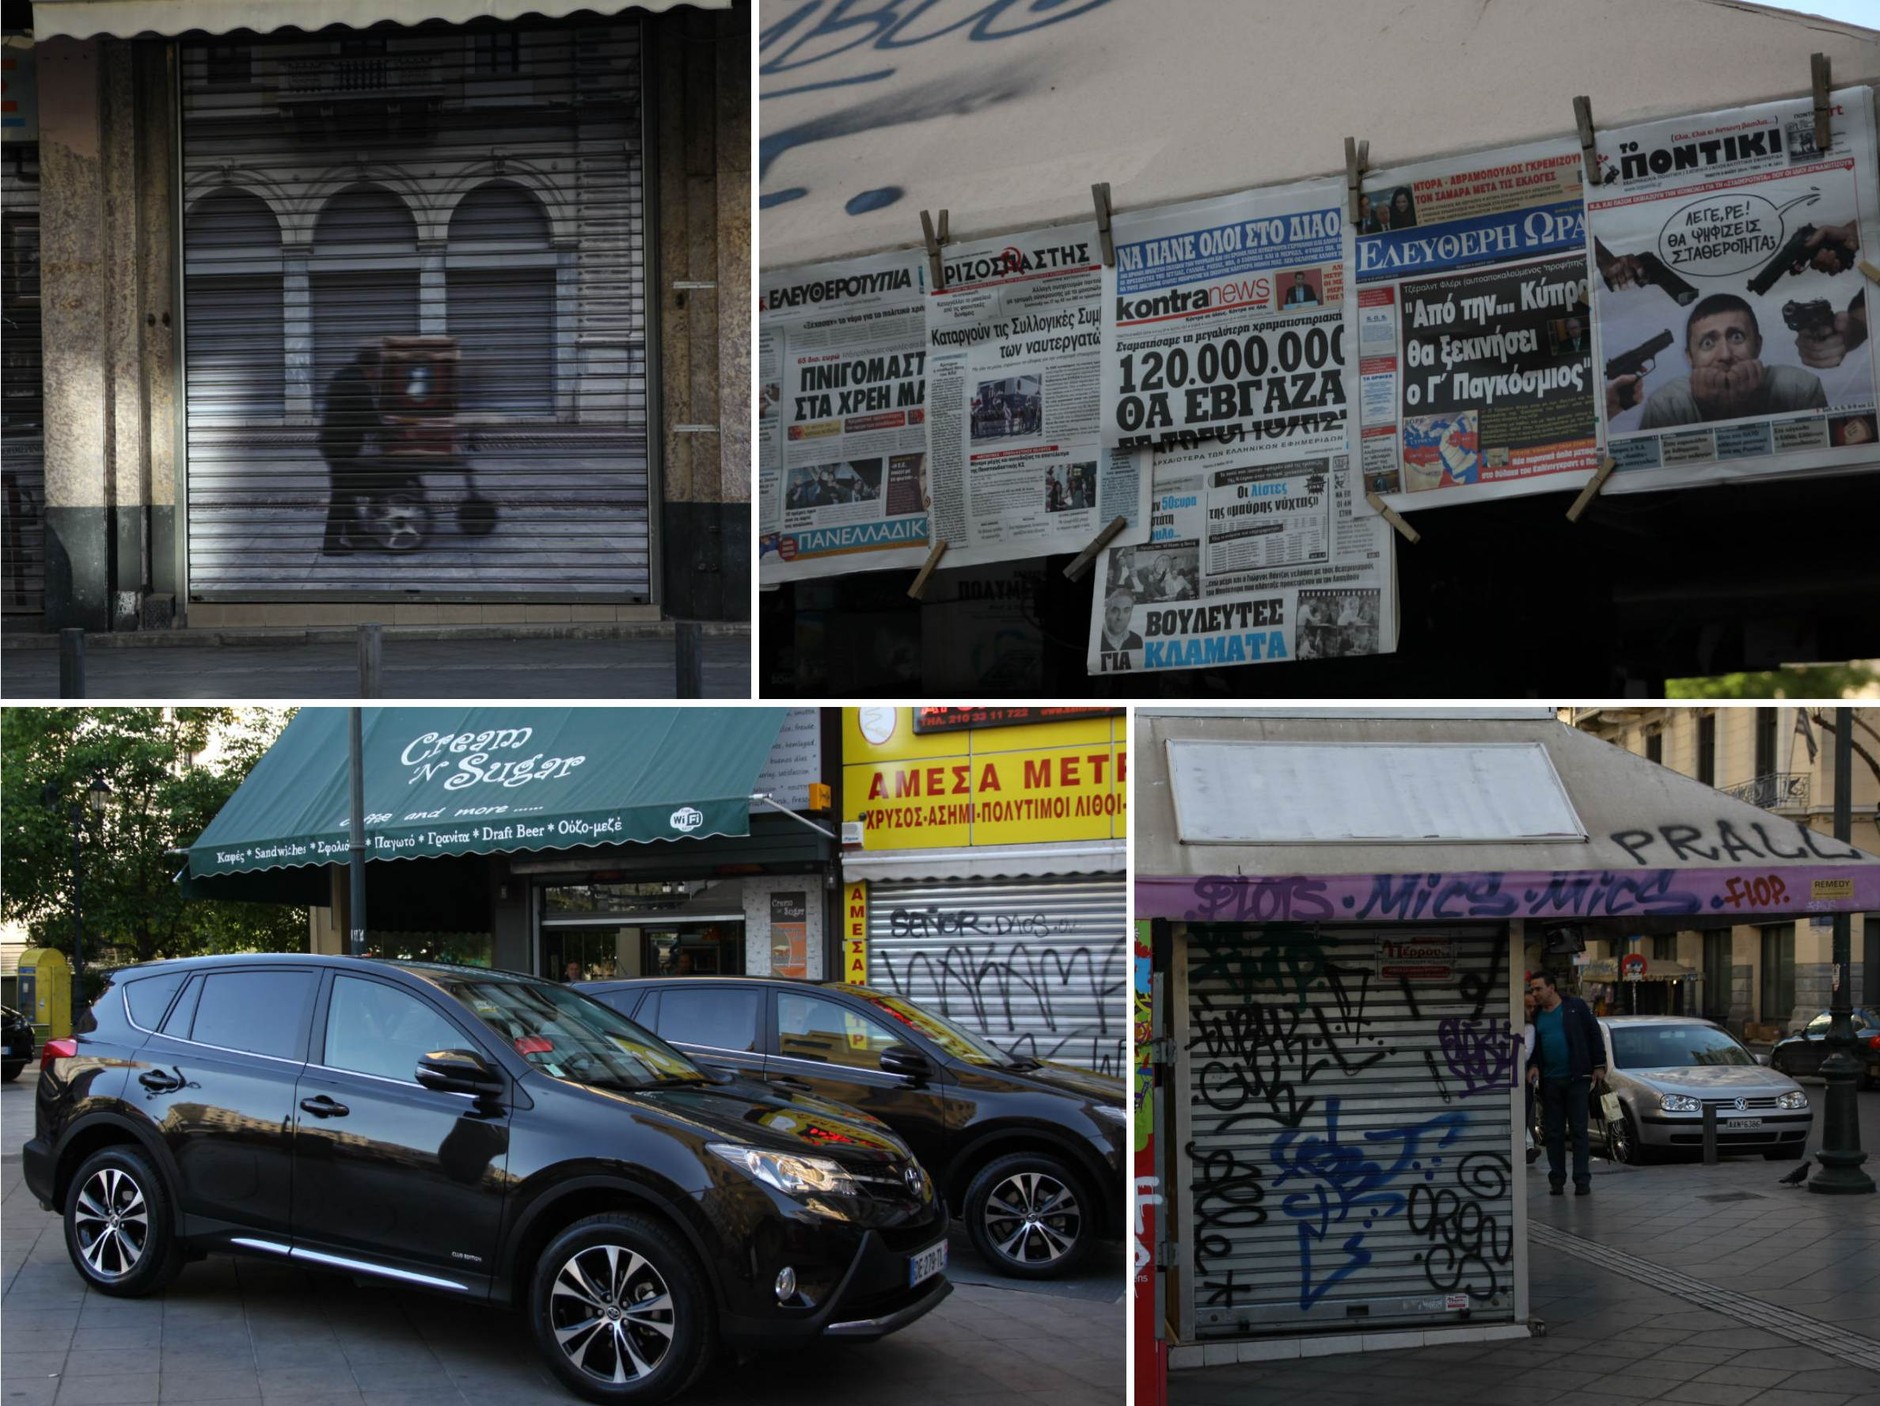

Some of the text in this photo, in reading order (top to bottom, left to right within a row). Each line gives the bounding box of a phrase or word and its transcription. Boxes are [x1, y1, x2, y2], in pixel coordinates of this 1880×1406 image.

[1619, 141, 1639, 153] ΤΟ
[1620, 128, 1783, 179] ΠΟΝΤΙΚΙ
[1414, 178, 1443, 192] ΝΤΟΡΑ
[1450, 165, 1524, 185] ΑΒΡΑΜΟΠΟΥΛΟΣ
[1415, 172, 1557, 205] ΤΟΝ ΣΑΜΑΡΑ ΜΕΤΑ ΤΙΣ ΕΚΛΟΓΕΣ
[1724, 201, 1750, 221] ΡΕ!
[1119, 247, 1142, 271] ΝΑ
[1146, 235, 1195, 267] ΠΑΝΕ
[1200, 226, 1242, 256] ΟΛΟΙ
[1245, 219, 1284, 246] ΣΤΟ
[1289, 210, 1342, 241] ΔΙΑΟ
[1357, 223, 1518, 273] ΕΛΕΥΘΕΡΗ
[1523, 211, 1587, 247] ΩΡΑ
[1667, 233, 1686, 248] ΘΑ
[769, 268, 912, 310] ΕΛΕΥΘΕΡΟΤΥΠΙΑ
[1116, 278, 1270, 322] kontranews
[931, 306, 1101, 348] Καταργούν τις Συλλογικές Συμ
[1405, 293, 1456, 329] "Από
[1461, 293, 1516, 326] την...
[1000, 343, 1022, 359] των
[1026, 327, 1101, 355] ναυτεργατώ
[1116, 334, 1181, 353] Σταματήσαμε
[1183, 334, 1194, 343] τη
[1195, 324, 1251, 343] μεγαλύτερη
[1252, 312, 1343, 333] χρηματιστηριακή
[1407, 339, 1435, 368] θα
[1440, 325, 1538, 371] ξεκινήσει
[801, 350, 926, 392] ΠΝΙΓΟΜΑΣΤ
[1407, 383, 1421, 406] ο
[1453, 356, 1591, 406] Παγκόσμιος"
[795, 379, 925, 421] ΣΤΑ ΧΡΕΗ ΜΑ
[1116, 391, 1173, 432] ΘΑ
[1184, 369, 1347, 424] ΕΒΓΑΖΑ
[1152, 453, 1206, 467] ΑΡΧΑΙΟΤΕΡΑ
[1237, 485, 1249, 499] Οι
[1209, 507, 1225, 521] της
[1226, 499, 1273, 519] «μαύρης
[799, 520, 925, 550] ΠΑΝΕΛΛΑΔΙΚ
[1145, 598, 1283, 637] ΒΟΥΛΕΥΤΕΣ
[1101, 631, 1287, 672] ΓΙΑ ΚΛΑΜΑΤΑ
[920, 708, 1028, 726] ΤΗΛ. 210 33 11 722
[400, 726, 533, 766] Cream
[443, 753, 586, 791] Sugar
[868, 763, 1001, 801] ΑΜΕΣΑ
[339, 812, 393, 827] cffee
[404, 807, 446, 821] and
[454, 804, 509, 818] more
[482, 823, 545, 841] Draft Beer
[558, 816, 623, 837] Ούζο-μεζέ
[255, 843, 307, 860] Sandwiches
[374, 835, 416, 852] Παγωτό
[427, 830, 470, 847] Γρανίτα
[217, 849, 245, 864] Καφές
[1814, 879, 1851, 888] REMEDY
[850, 887, 865, 971] ΑΜΕΣΑ
